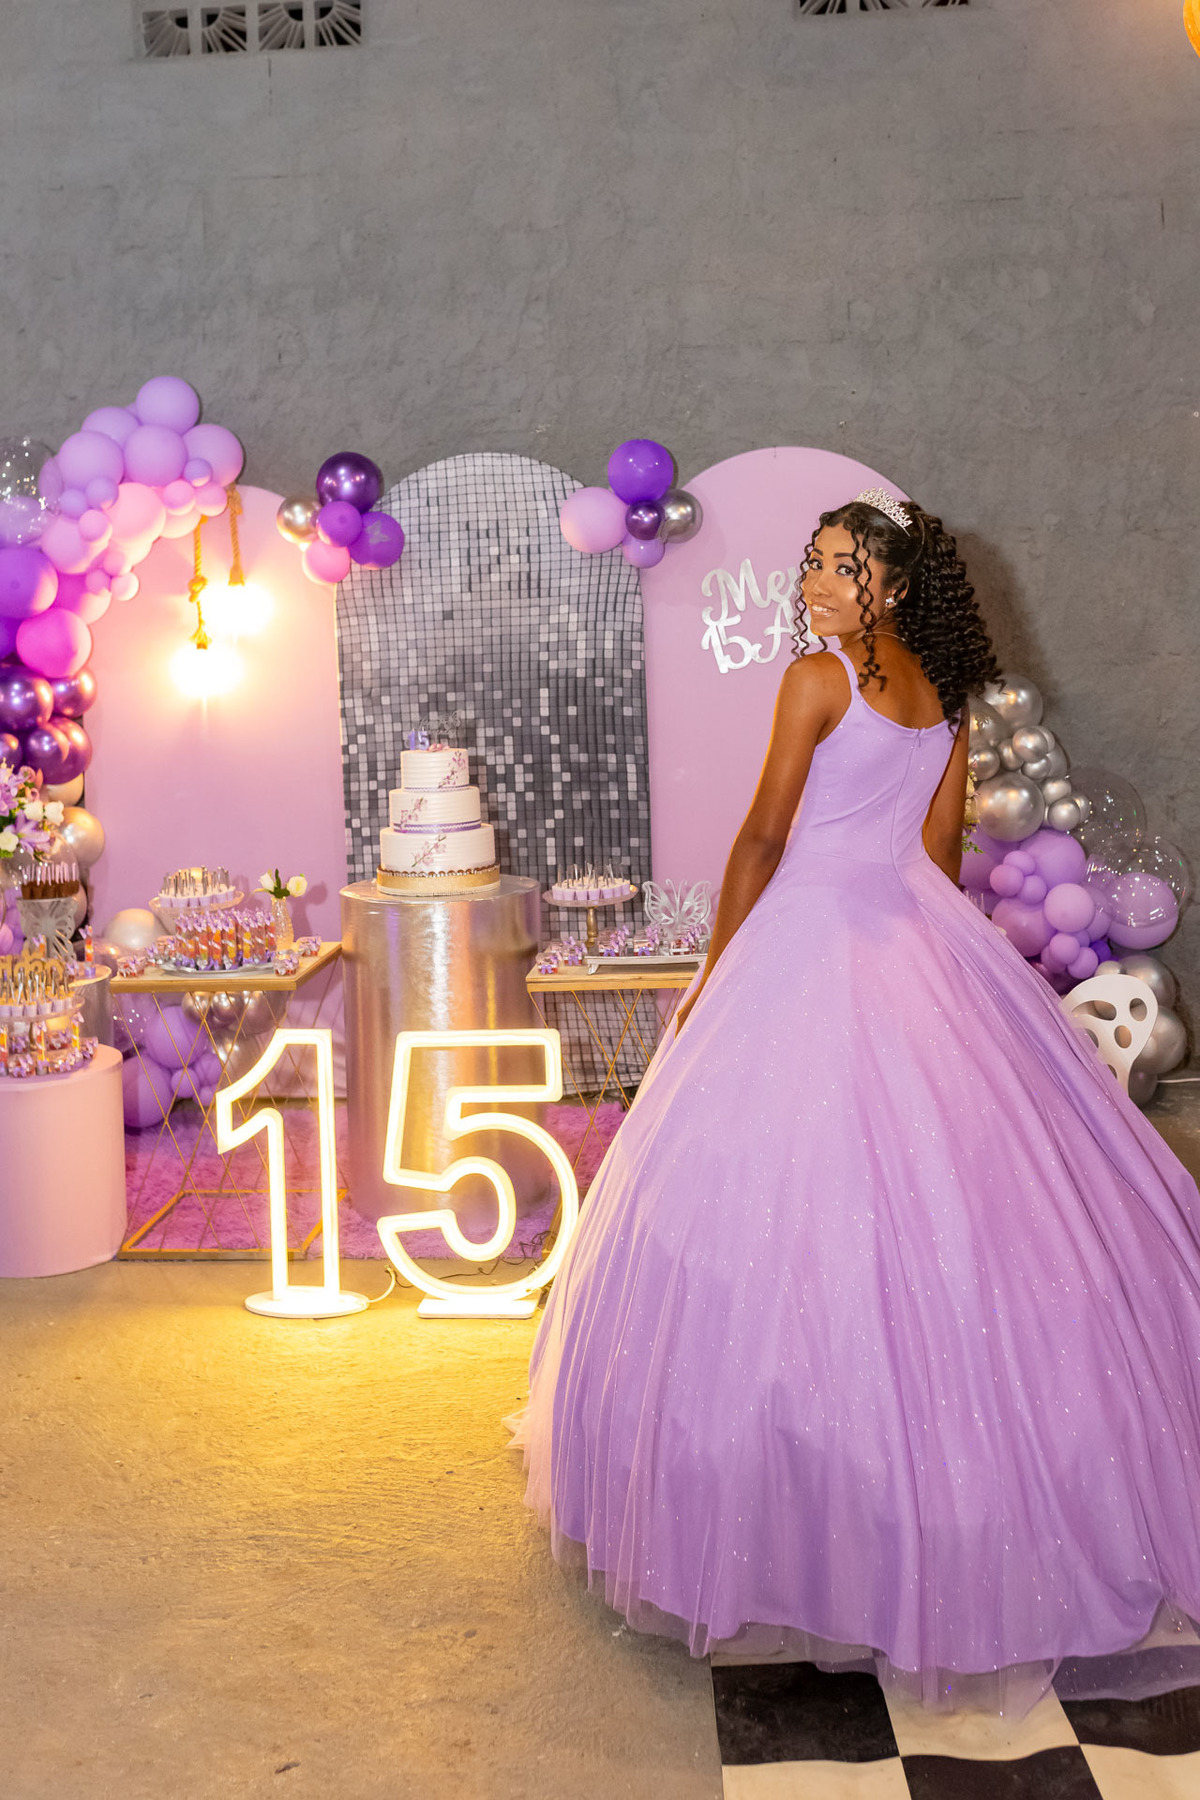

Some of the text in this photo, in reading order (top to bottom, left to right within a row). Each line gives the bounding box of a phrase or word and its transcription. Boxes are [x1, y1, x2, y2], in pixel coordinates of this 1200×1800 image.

[701, 613, 752, 674] 15
[407, 730, 430, 750] 15
[215, 1028, 579, 1302] 15
